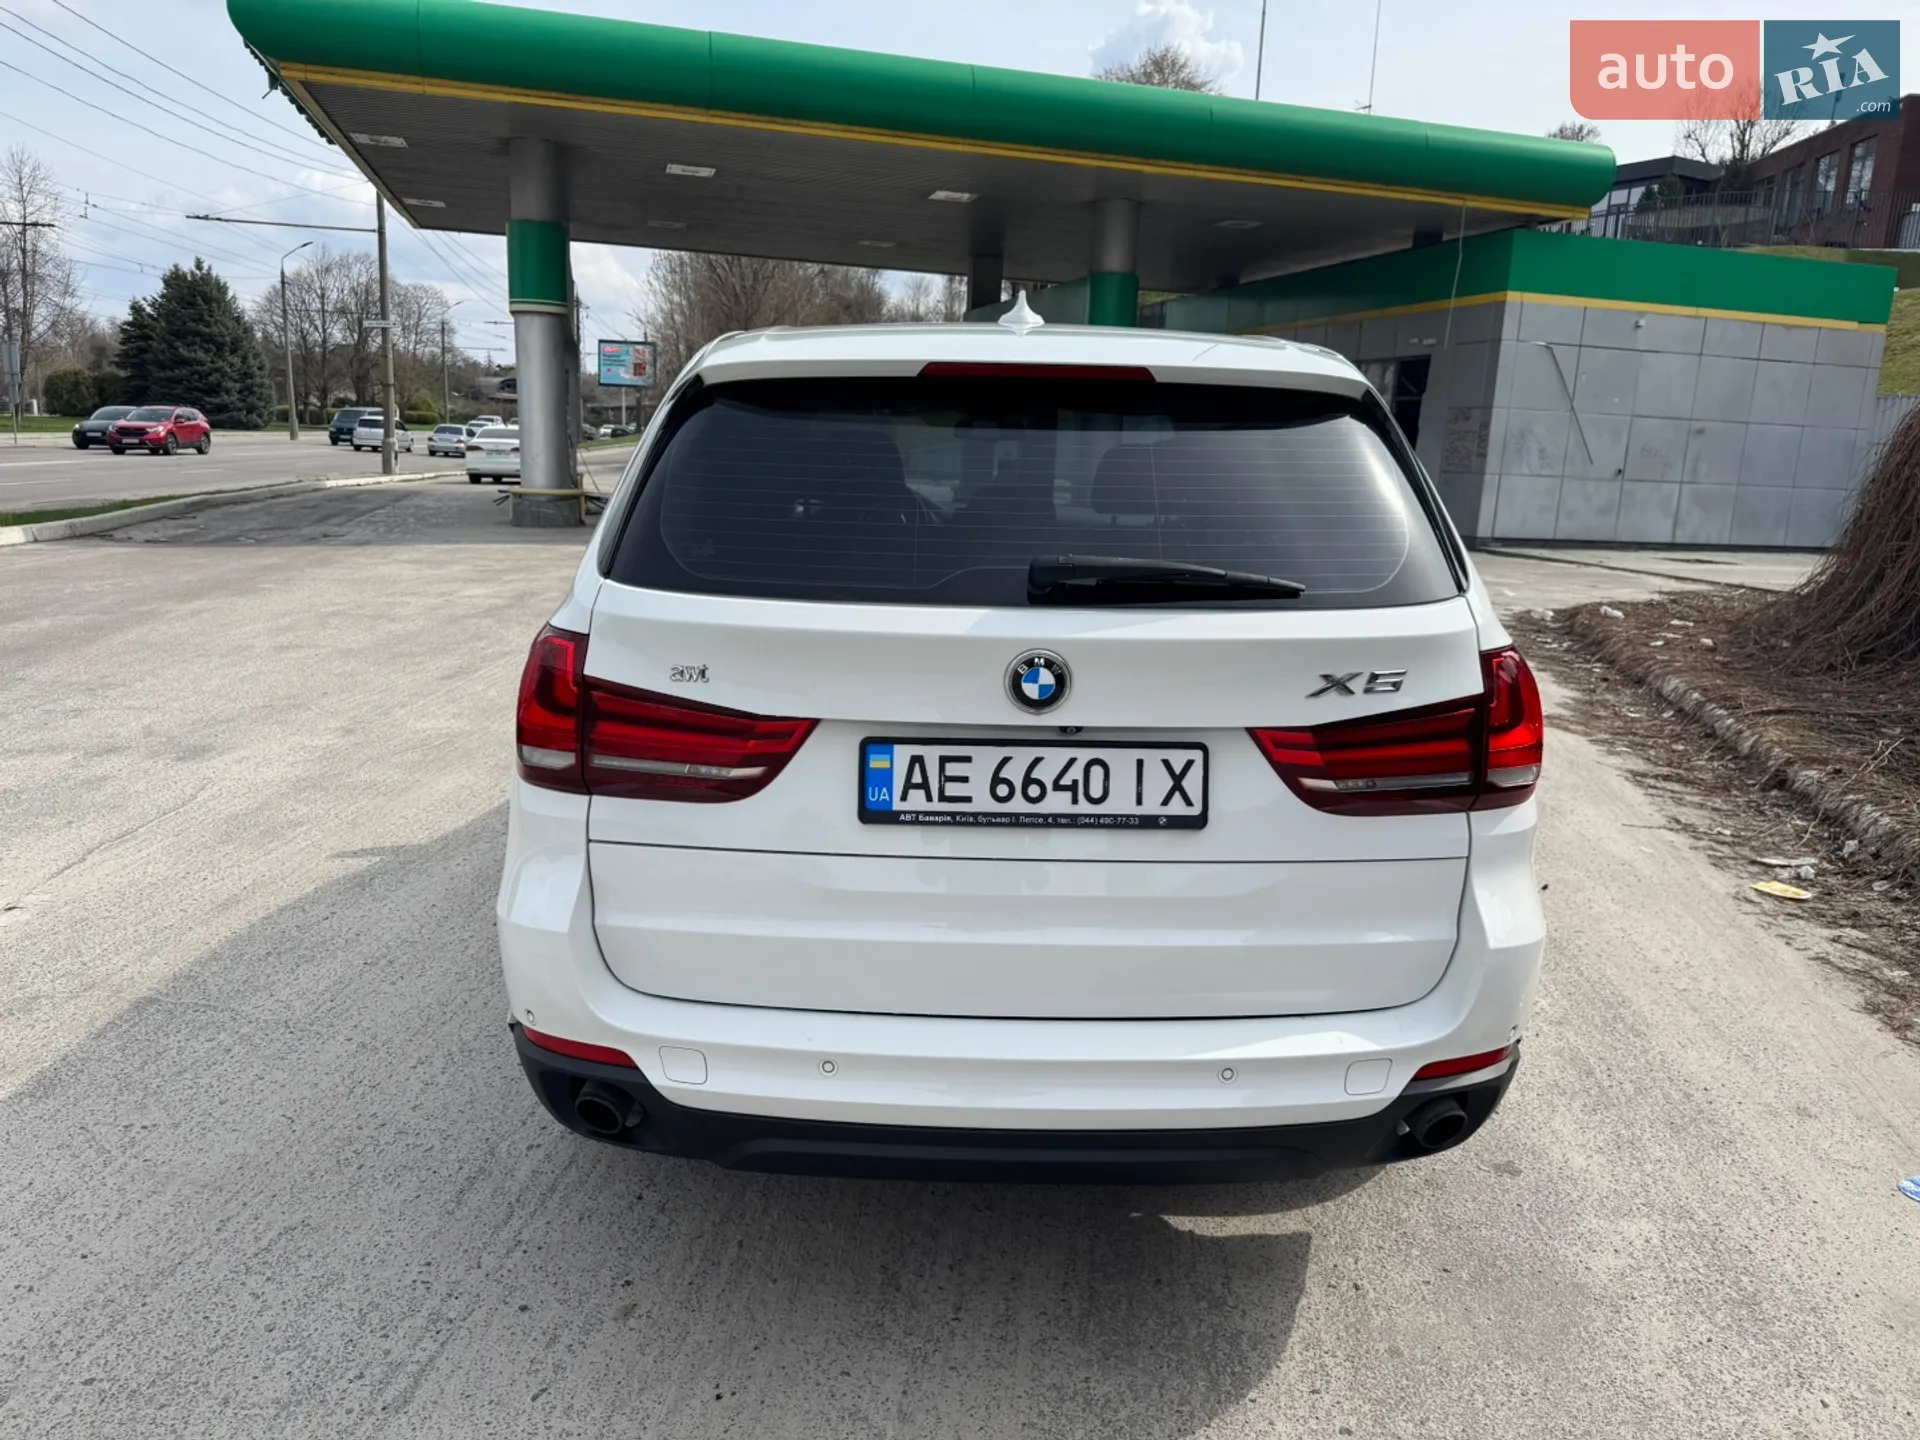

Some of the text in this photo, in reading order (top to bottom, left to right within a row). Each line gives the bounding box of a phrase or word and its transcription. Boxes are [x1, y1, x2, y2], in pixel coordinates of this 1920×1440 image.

[1017, 657, 1062, 675] BMW
[1304, 669, 1408, 698] X5
[900, 755, 1196, 808] AE 6640 IX
[868, 786, 890, 802] UA
